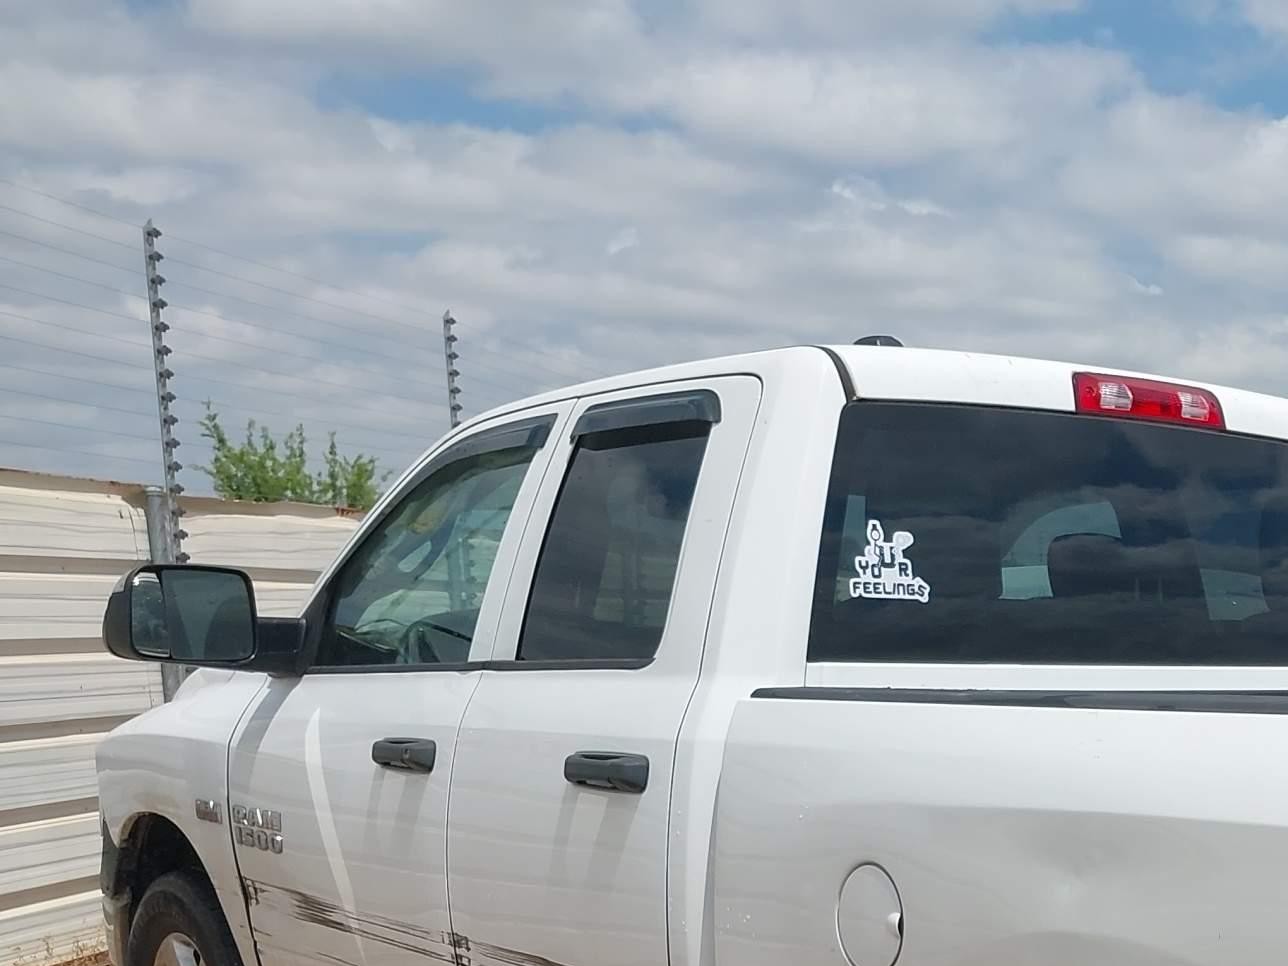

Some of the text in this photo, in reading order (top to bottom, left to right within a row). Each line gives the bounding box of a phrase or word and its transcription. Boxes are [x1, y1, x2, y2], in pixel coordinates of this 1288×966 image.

[852, 581, 927, 597] FEELINGS
[232, 804, 282, 832] RAM
[235, 825, 284, 854] 1500
